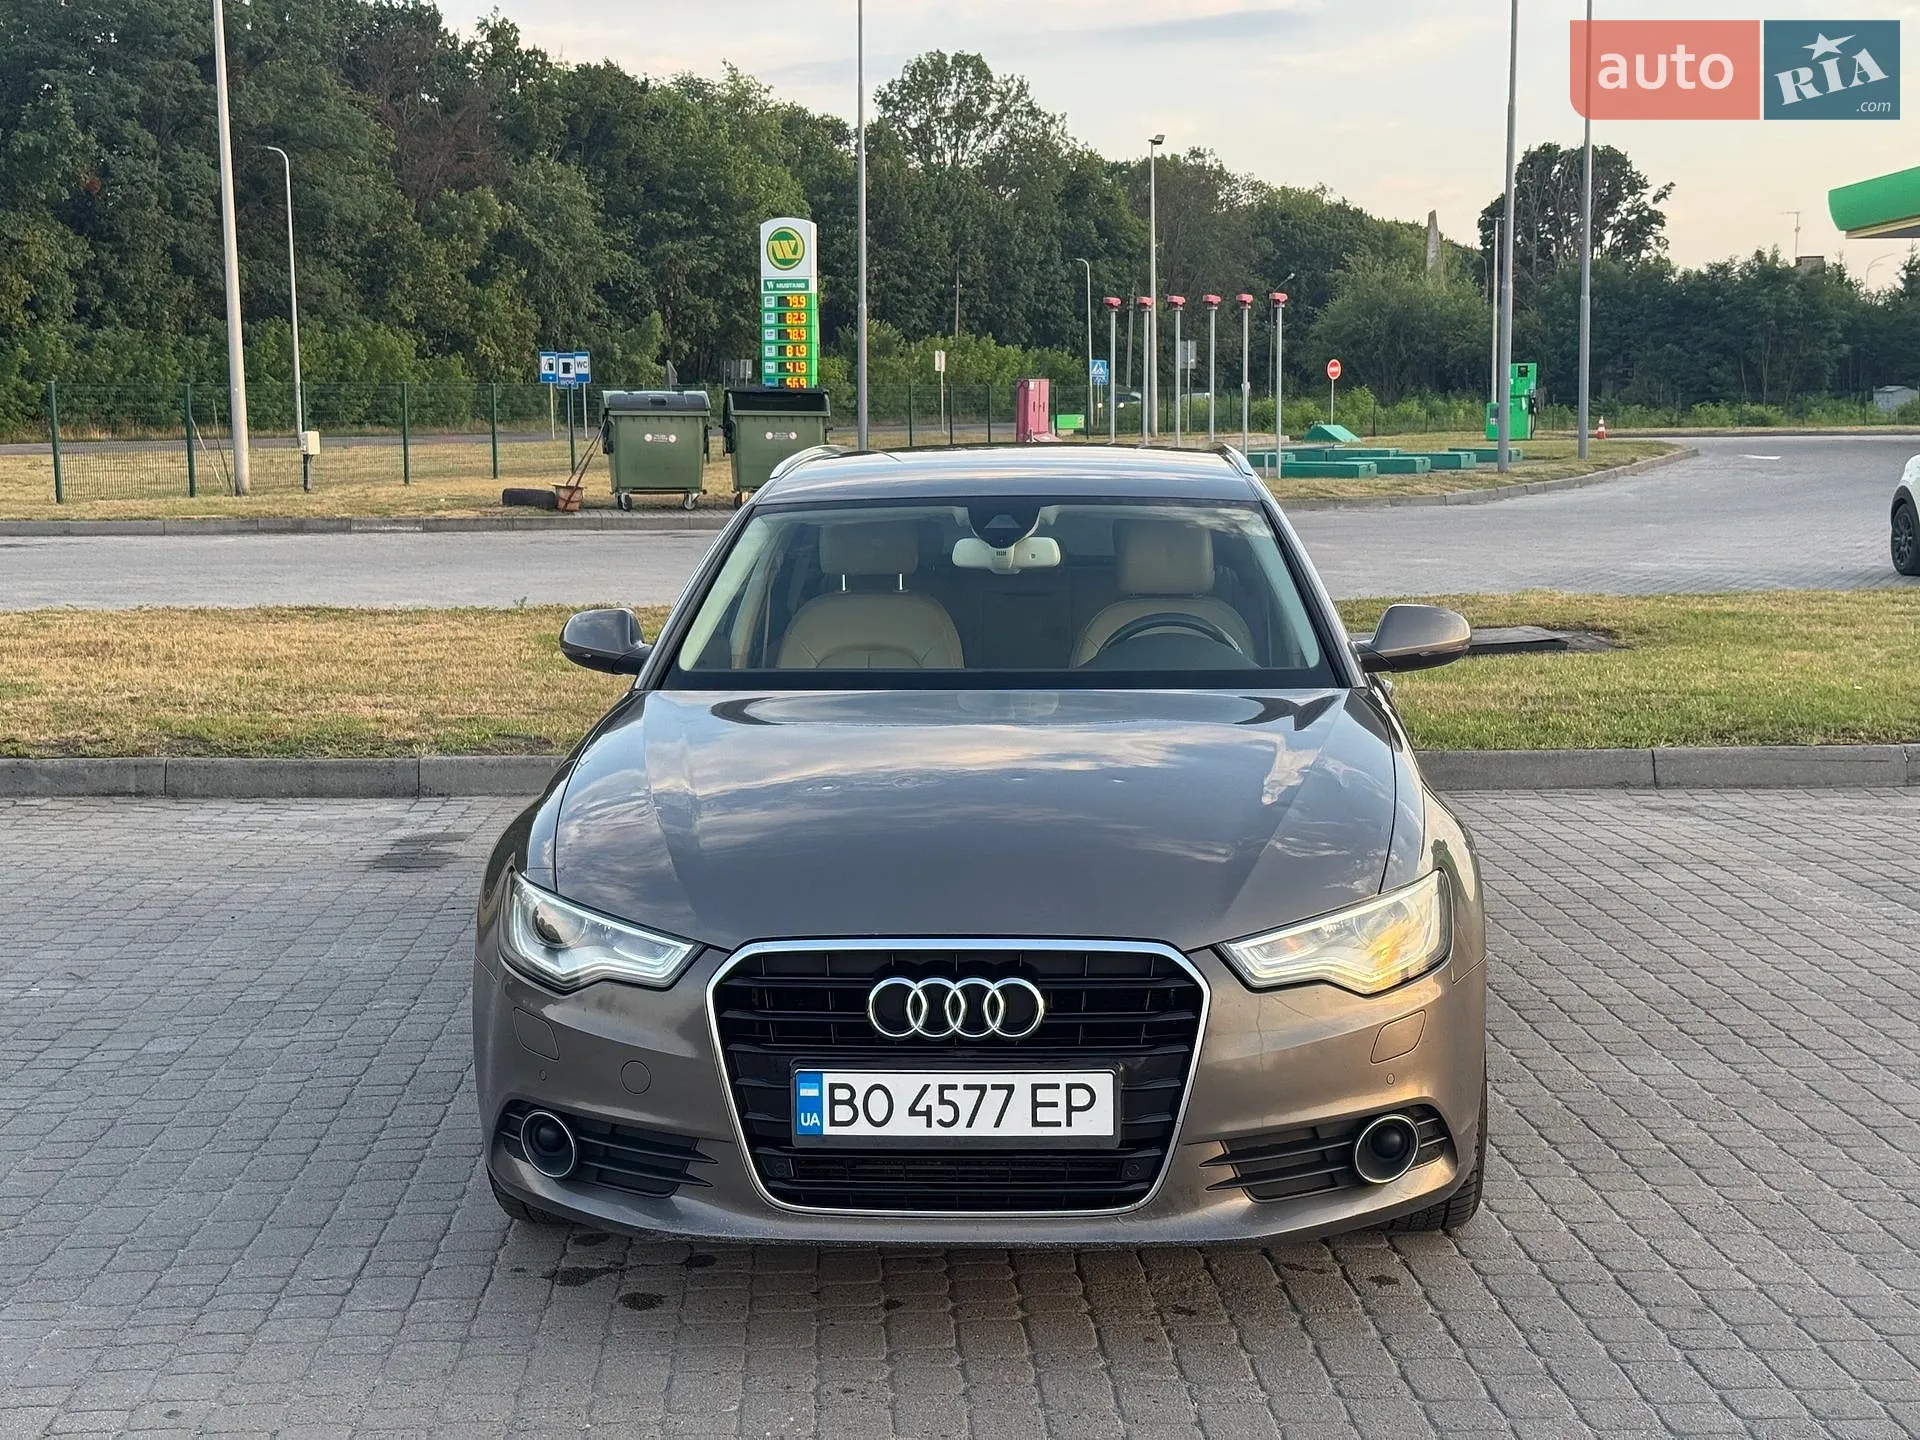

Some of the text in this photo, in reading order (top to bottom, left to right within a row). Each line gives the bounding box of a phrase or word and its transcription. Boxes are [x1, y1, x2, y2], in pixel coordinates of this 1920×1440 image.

[800, 1112, 821, 1127] UA
[828, 1082, 1097, 1129] BO 4577 EP
